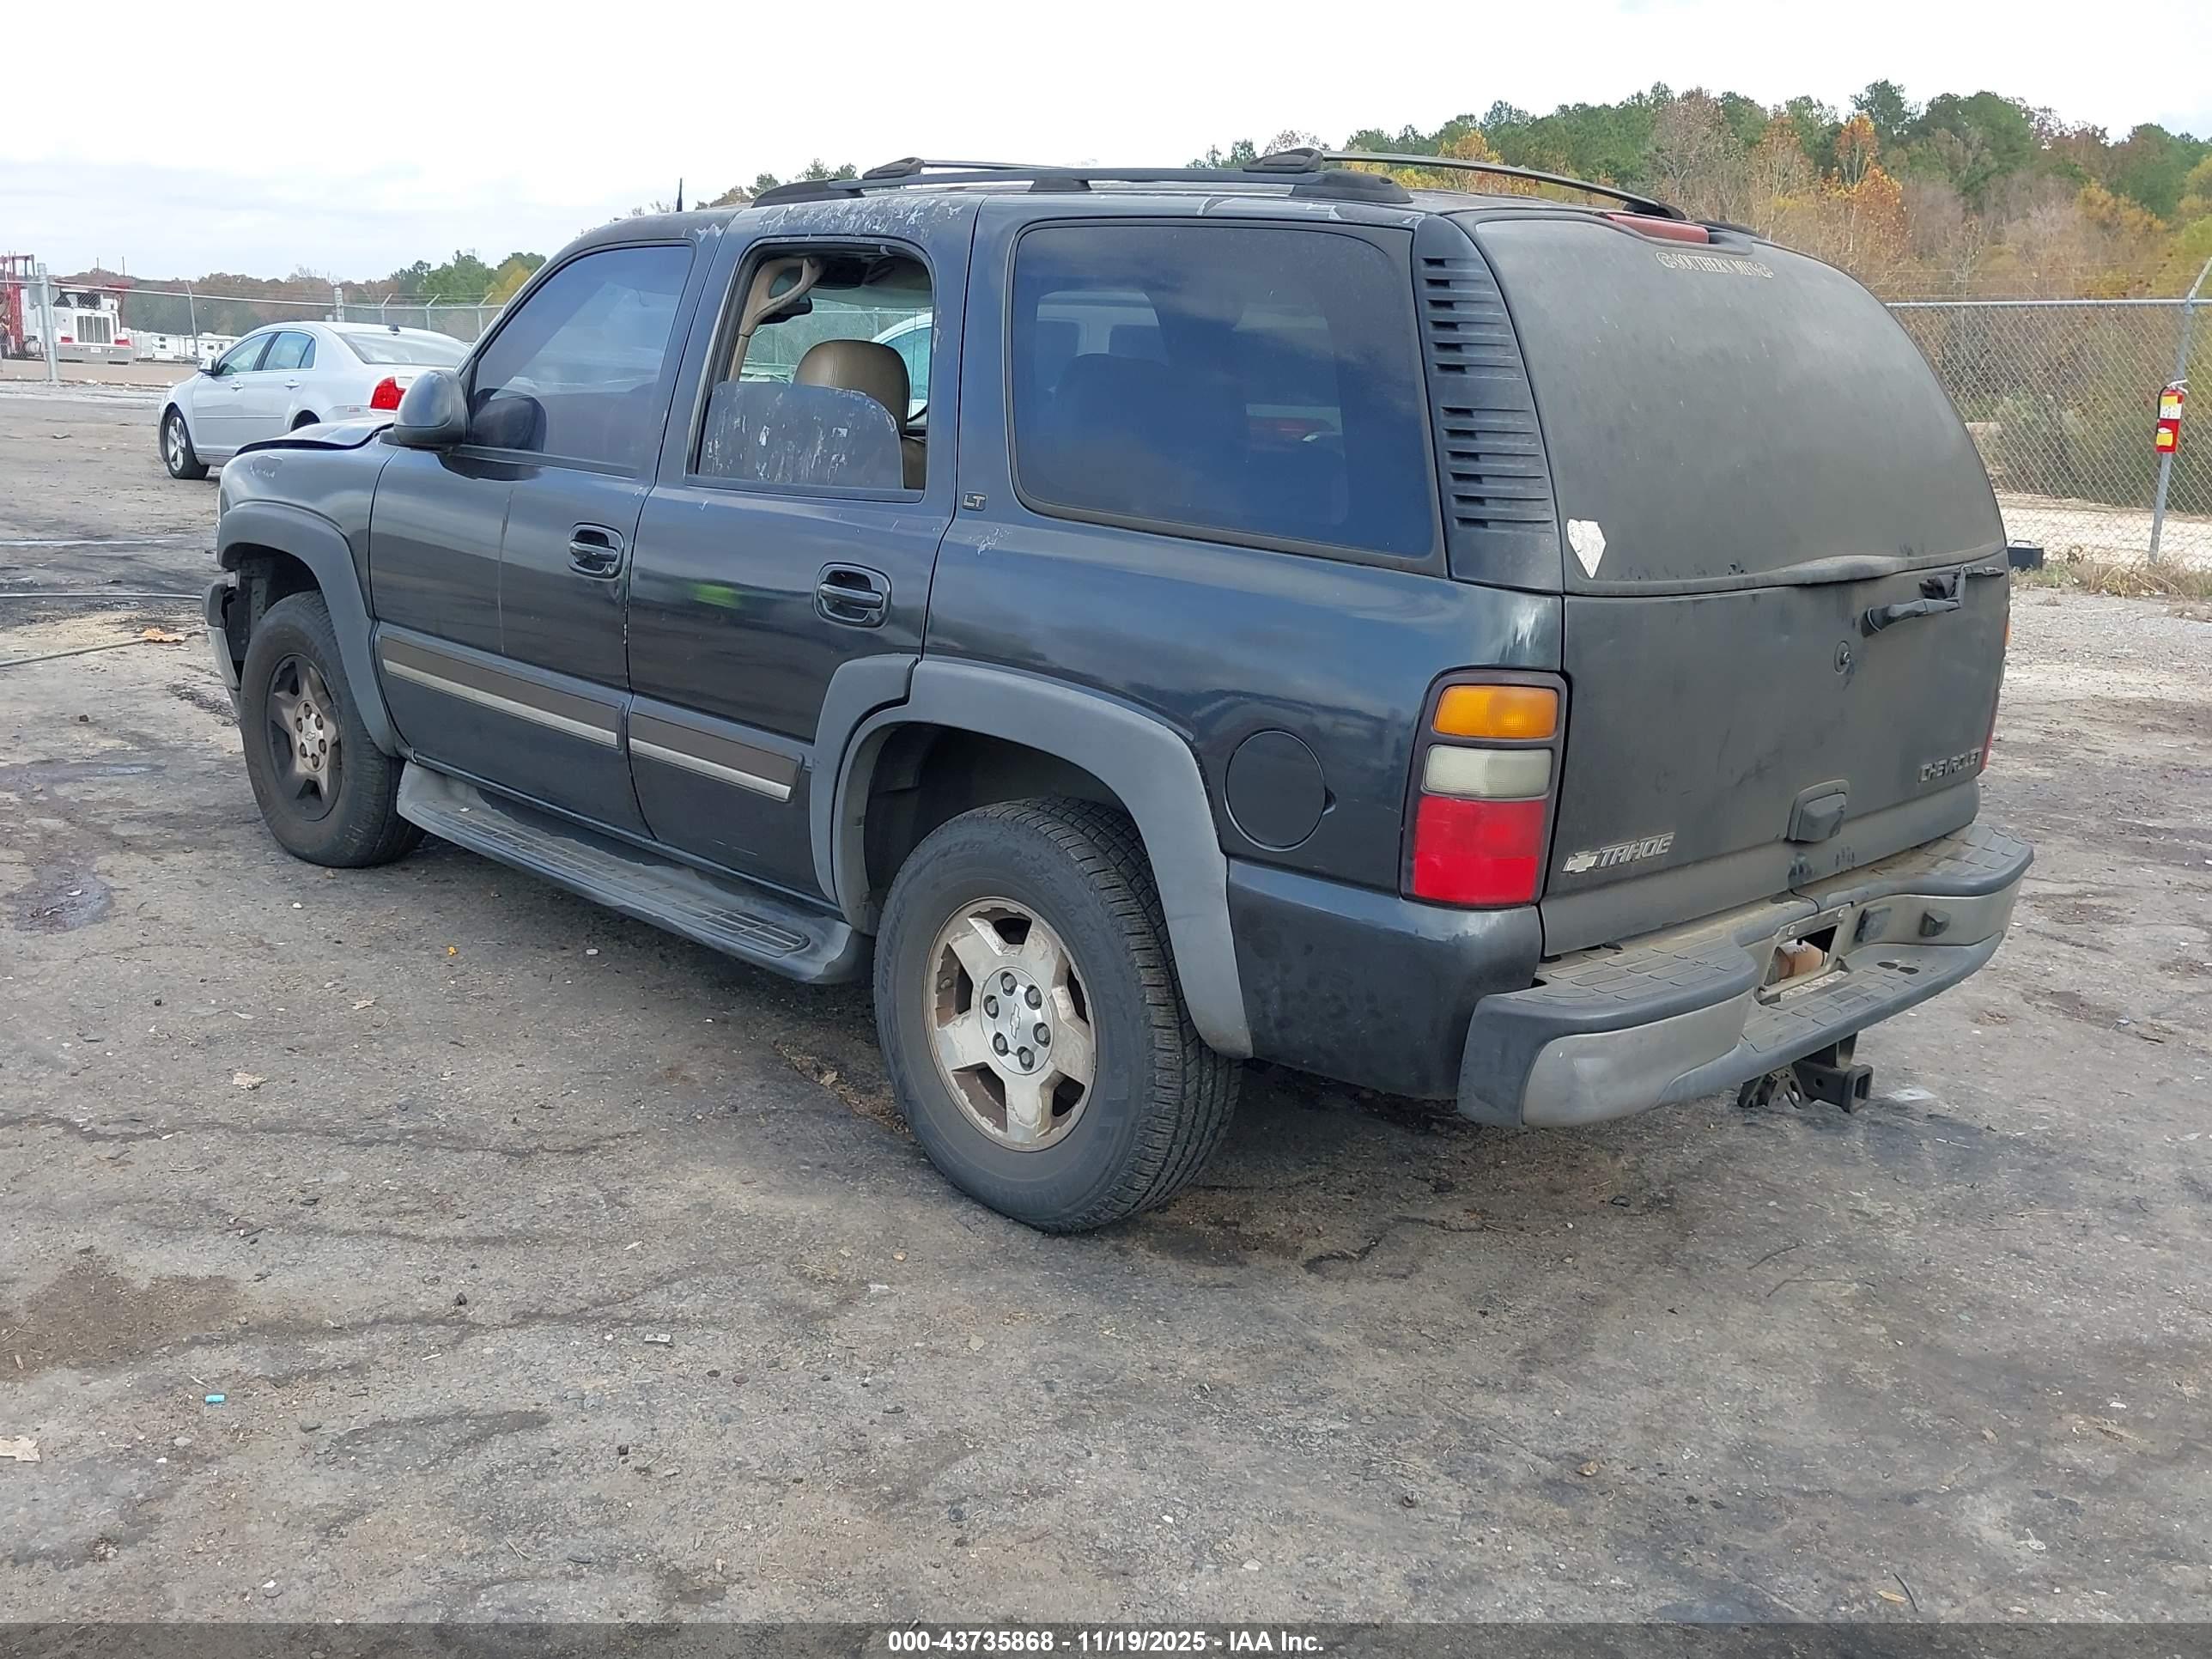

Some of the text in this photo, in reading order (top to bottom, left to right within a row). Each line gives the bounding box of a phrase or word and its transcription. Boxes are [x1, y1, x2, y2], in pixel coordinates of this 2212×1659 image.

[1672, 253, 1733, 275] SOUTHERN
[963, 494, 986, 507] LT
[1917, 747, 1984, 782] CHEVROLET
[1599, 832, 1674, 867] TAHOE
